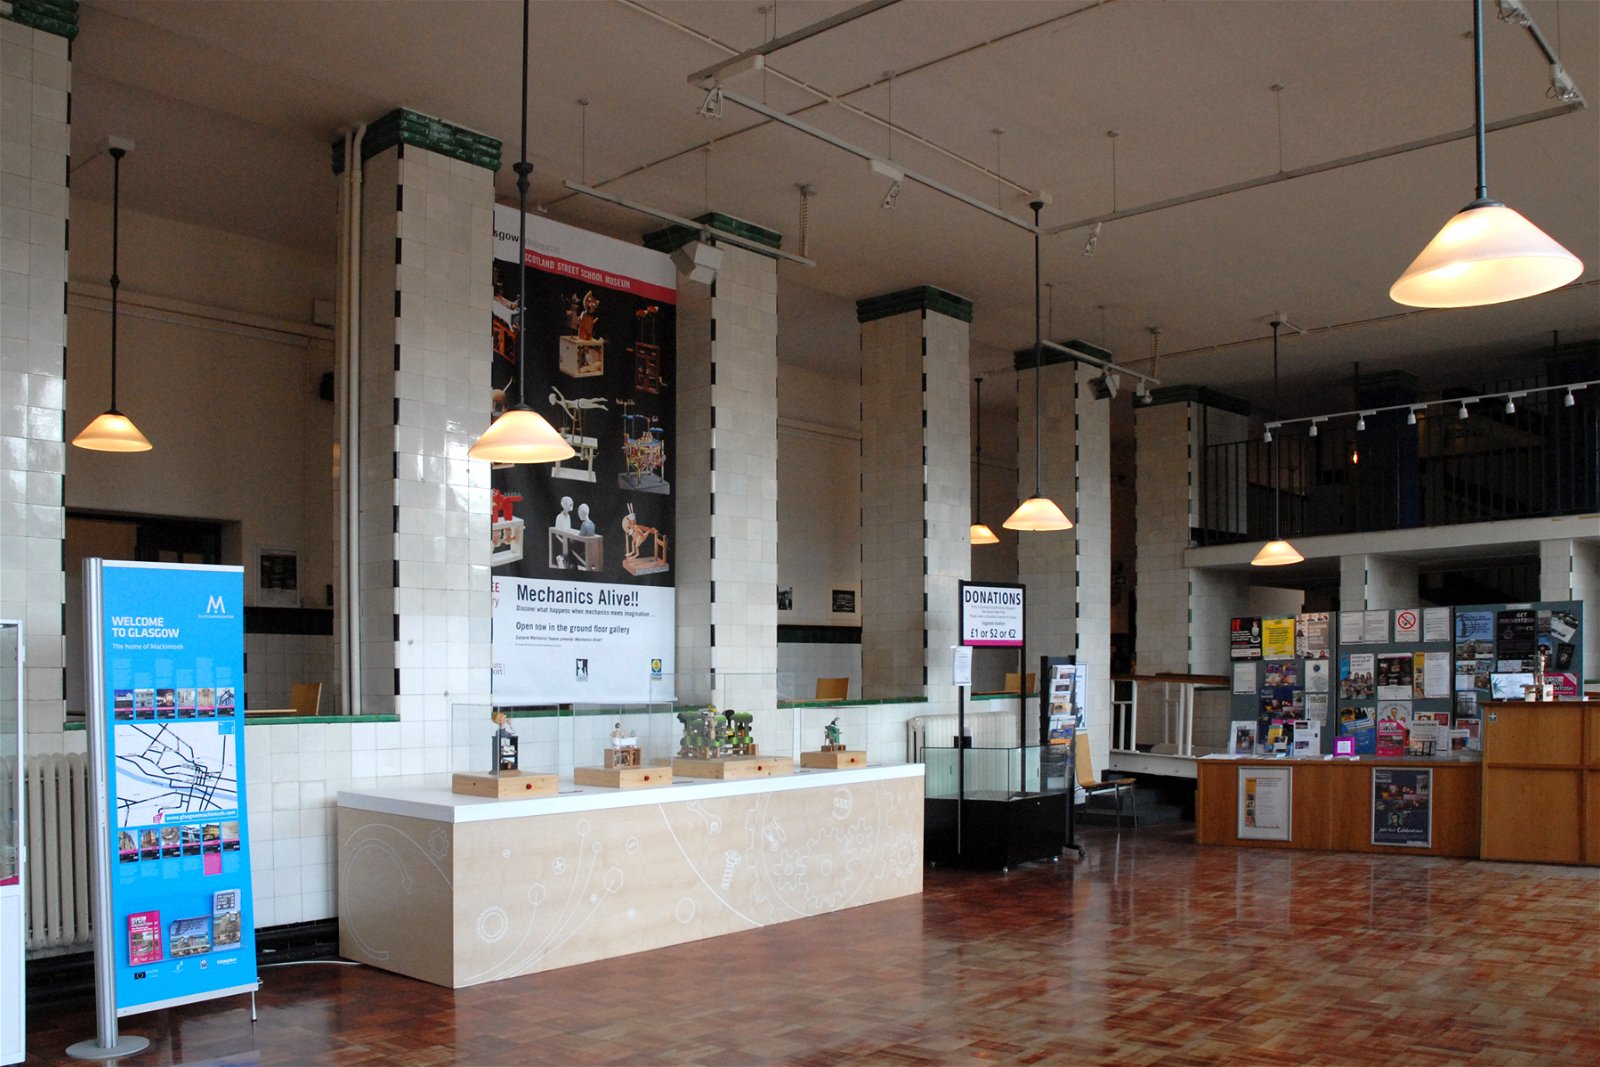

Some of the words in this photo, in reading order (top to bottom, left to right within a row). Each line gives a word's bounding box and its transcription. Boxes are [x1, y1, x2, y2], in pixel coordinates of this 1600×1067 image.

[524, 253, 554, 269] SCOTLAND
[557, 262, 580, 275] STREET
[581, 268, 603, 283] SCHOOL
[605, 275, 631, 289] MUSEUM
[517, 583, 593, 605] Mechanics
[598, 589, 639, 607] Alive!!
[965, 590, 1021, 605] DONATIONS
[549, 606, 570, 614] happens
[111, 616, 164, 627] WELCOME
[111, 627, 126, 638] TO
[128, 627, 180, 638] GLASGOW
[516, 621, 533, 631] Open
[549, 623, 555, 631] in
[570, 624, 592, 633] ground
[594, 625, 607, 633] floor
[609, 626, 630, 635] gallery
[971, 628, 978, 638] £1
[980, 630, 988, 638] or
[1000, 630, 1007, 638] or
[1009, 629, 1016, 638] €2
